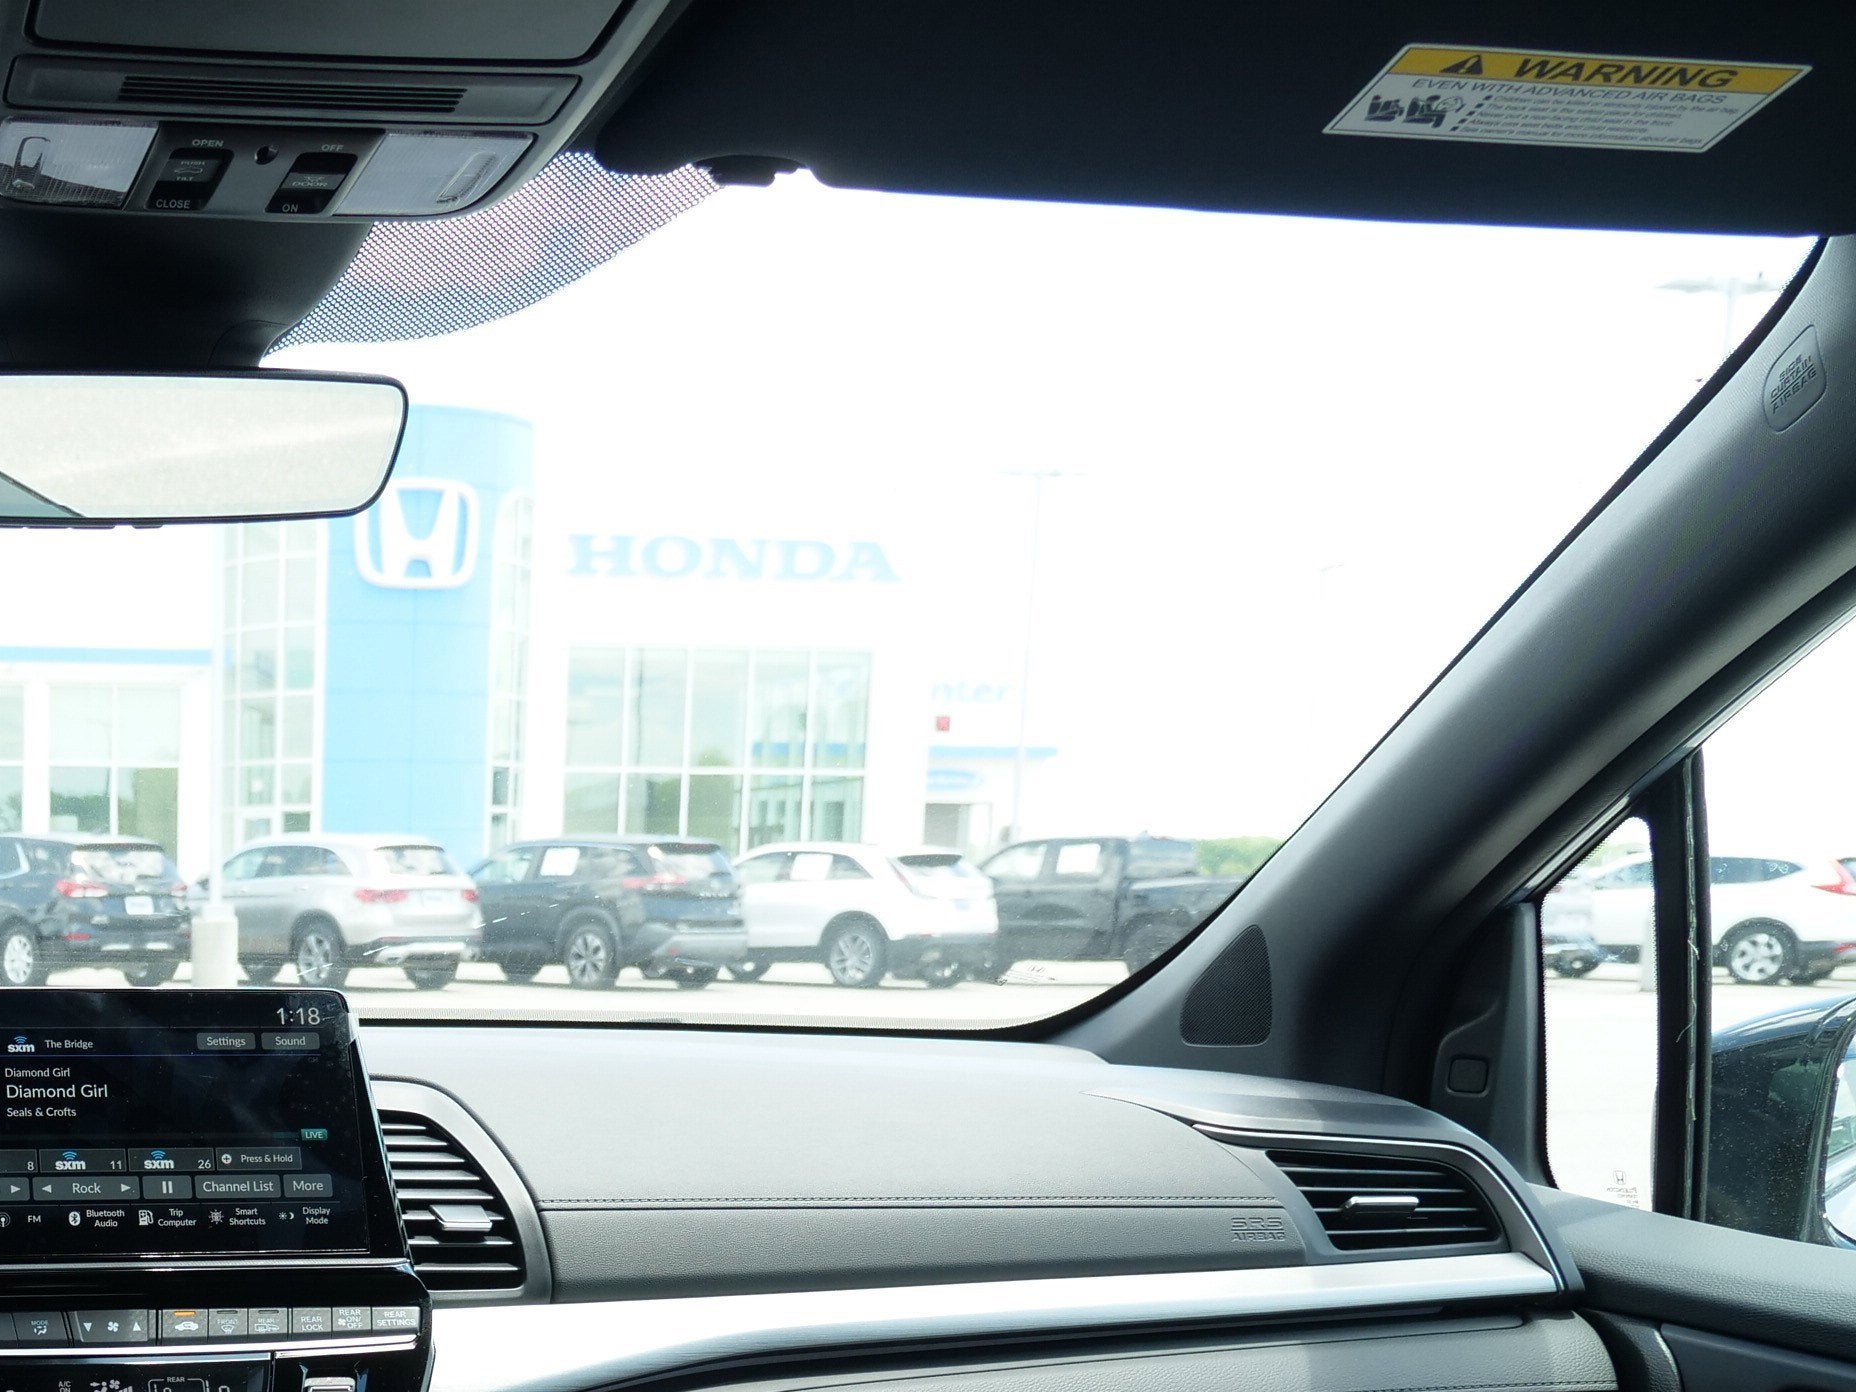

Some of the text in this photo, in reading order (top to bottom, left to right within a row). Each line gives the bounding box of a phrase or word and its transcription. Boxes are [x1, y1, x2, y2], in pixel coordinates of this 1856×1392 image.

[1514, 58, 1738, 88] WARNING
[1413, 78, 1468, 90] EVEN
[1471, 81, 1520, 93] WITH
[1523, 85, 1633, 99] ADVANCED
[1635, 91, 1669, 101] AIR
[1670, 94, 1728, 104] BAGS
[192, 139, 224, 147] OPEN
[321, 144, 344, 152] OFF
[156, 200, 191, 209] CLOSE
[282, 204, 299, 212] ON
[567, 533, 901, 583] HONDA
[932, 682, 1012, 703] nter
[276, 1007, 320, 1025] 1:18
[44, 1039, 93, 1050] The Bridge
[206, 1036, 246, 1047] Settings
[275, 1036, 305, 1046] Sound
[7, 1043, 35, 1053] sxm
[5, 1068, 70, 1077] Diamond Girl
[6, 1084, 108, 1098] Diamond Girl
[6, 1107, 76, 1117] Seals & Crofts
[305, 1131, 324, 1139] LIVE
[240, 1154, 293, 1163] Press & Hold
[27, 1161, 34, 1171] 8
[55, 1160, 86, 1170] sxm
[110, 1160, 122, 1170] 11
[144, 1159, 175, 1169] sxm
[197, 1160, 212, 1169] 26
[72, 1183, 101, 1194] Rock
[203, 1180, 274, 1192] Channel List
[293, 1180, 324, 1191] More
[86, 1209, 125, 1218] Bluetooth
[168, 1208, 184, 1218] Trip
[235, 1208, 258, 1216] Smart
[302, 1206, 331, 1216] Display
[28, 1215, 41, 1223] FM
[94, 1219, 118, 1227] Audio
[158, 1218, 197, 1228] Computer
[229, 1217, 266, 1226] Shortcuts
[306, 1216, 329, 1225] Mode
[1231, 1216, 1284, 1229] SRS
[1231, 1232, 1285, 1241] AIRBAG
[301, 1316, 322, 1324] REAR
[346, 1315, 362, 1323] ON/
[384, 1311, 406, 1319] REAR
[302, 1323, 323, 1331] LOCK
[377, 1318, 416, 1326] SETTINGS
[58, 1380, 71, 1388] A/C
